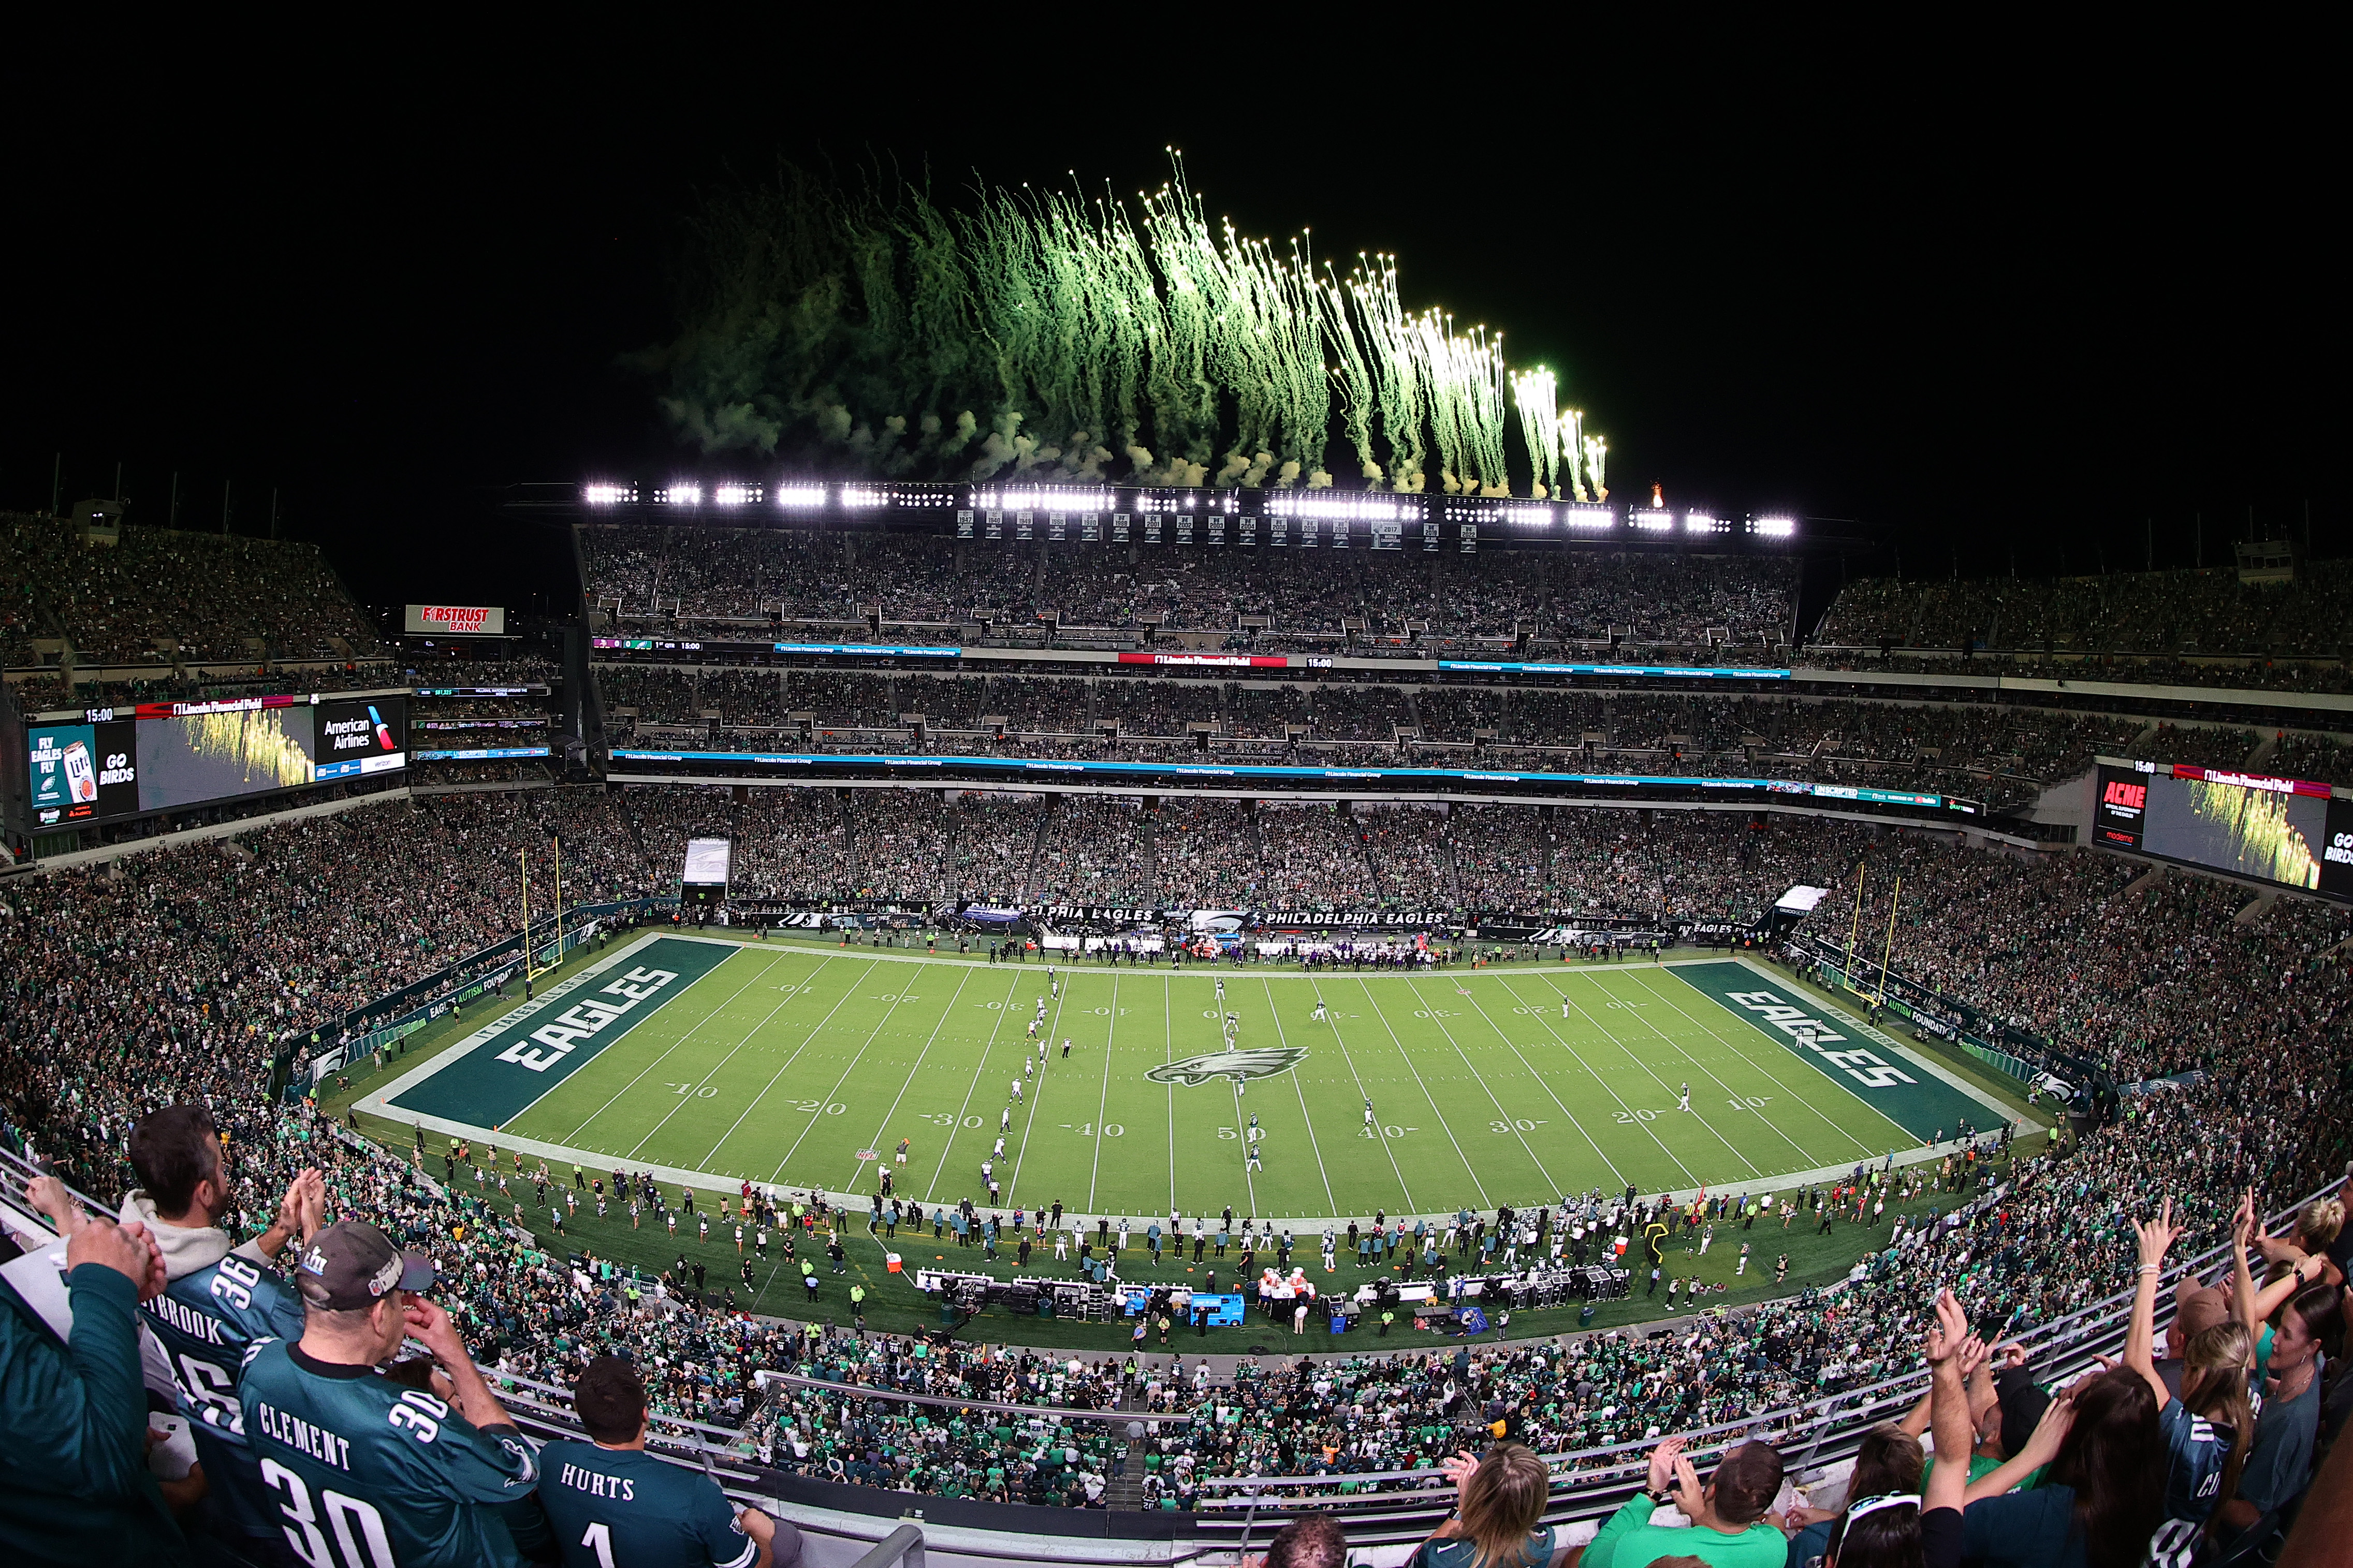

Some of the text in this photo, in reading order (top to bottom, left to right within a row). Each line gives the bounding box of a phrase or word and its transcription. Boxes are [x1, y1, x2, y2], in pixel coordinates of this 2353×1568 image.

[449, 622, 481, 632] BANK
[1164, 655, 1251, 666] Lincoln Financial Field
[1308, 658, 1332, 668] 15:00
[182, 698, 262, 715] Lincoln Financial Field
[311, 694, 319, 704] 25
[86, 708, 113, 722] 15:00
[324, 719, 369, 736] American
[38, 737, 54, 750] FLY
[334, 734, 369, 750] Airlines
[31, 748, 62, 763] EAGLES
[106, 753, 127, 769] GO
[454, 750, 488, 758] UNSCRIPTED
[40, 761, 55, 773] FLY
[69, 754, 89, 778] Lite
[2135, 760, 2155, 773] 15:00
[99, 767, 135, 786] BIRDS
[2213, 771, 2293, 793] Lincoln Financial Field
[1815, 785, 1858, 796] UNSCRIPTED
[2107, 831, 2133, 843] moderna
[2334, 832, 2353, 849] GO
[1091, 909, 1155, 921] EAGLES
[1266, 912, 1443, 925] PHILADELPHIA EAGLES
[458, 984, 483, 1003] AUTISM
[474, 972, 595, 1038] IT TAKES ALL OF US
[1888, 999, 1910, 1019] AUTISM
[493, 965, 679, 1073] EAGLES
[1824, 1008, 1901, 1049] END RACISM
[1724, 991, 1918, 1088] EAGLES
[210, 1255, 261, 1311] 36
[141, 1293, 225, 1345] TBROOK
[388, 1390, 449, 1443] 30
[259, 1402, 350, 1471] CLEMENT
[560, 1462, 635, 1501] HURTS
[260, 1458, 396, 1568] 30
[581, 1522, 616, 1568] 1
